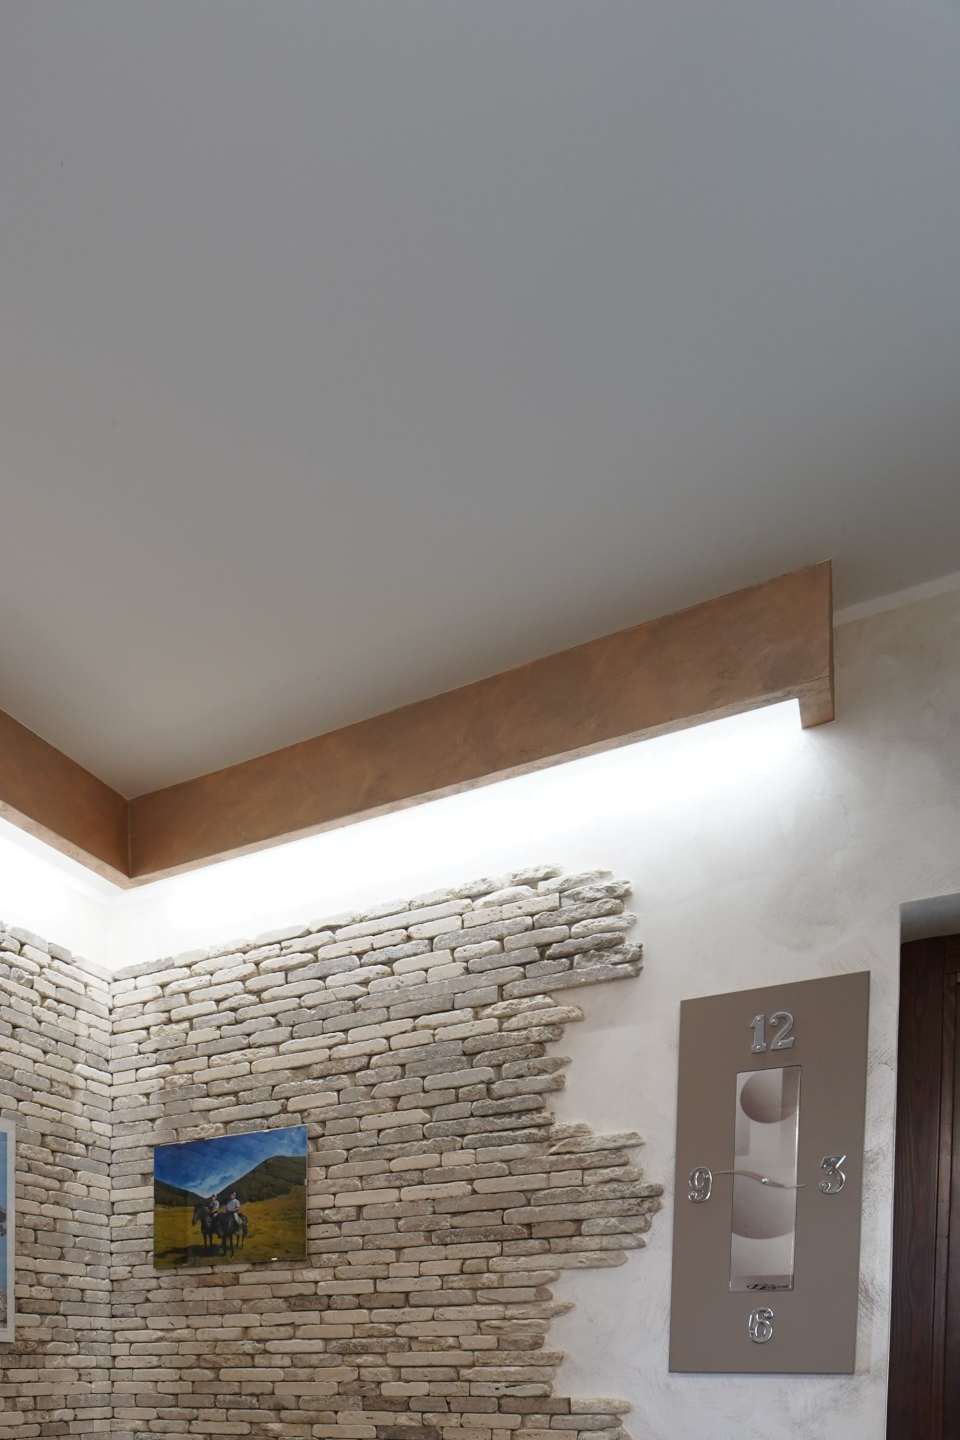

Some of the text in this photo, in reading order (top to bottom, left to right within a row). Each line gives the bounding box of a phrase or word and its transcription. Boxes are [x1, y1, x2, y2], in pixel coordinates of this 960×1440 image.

[749, 1011, 795, 1053] 12
[687, 1166, 712, 1201] 9
[818, 1155, 846, 1194] 3
[748, 1308, 774, 1344] 6
